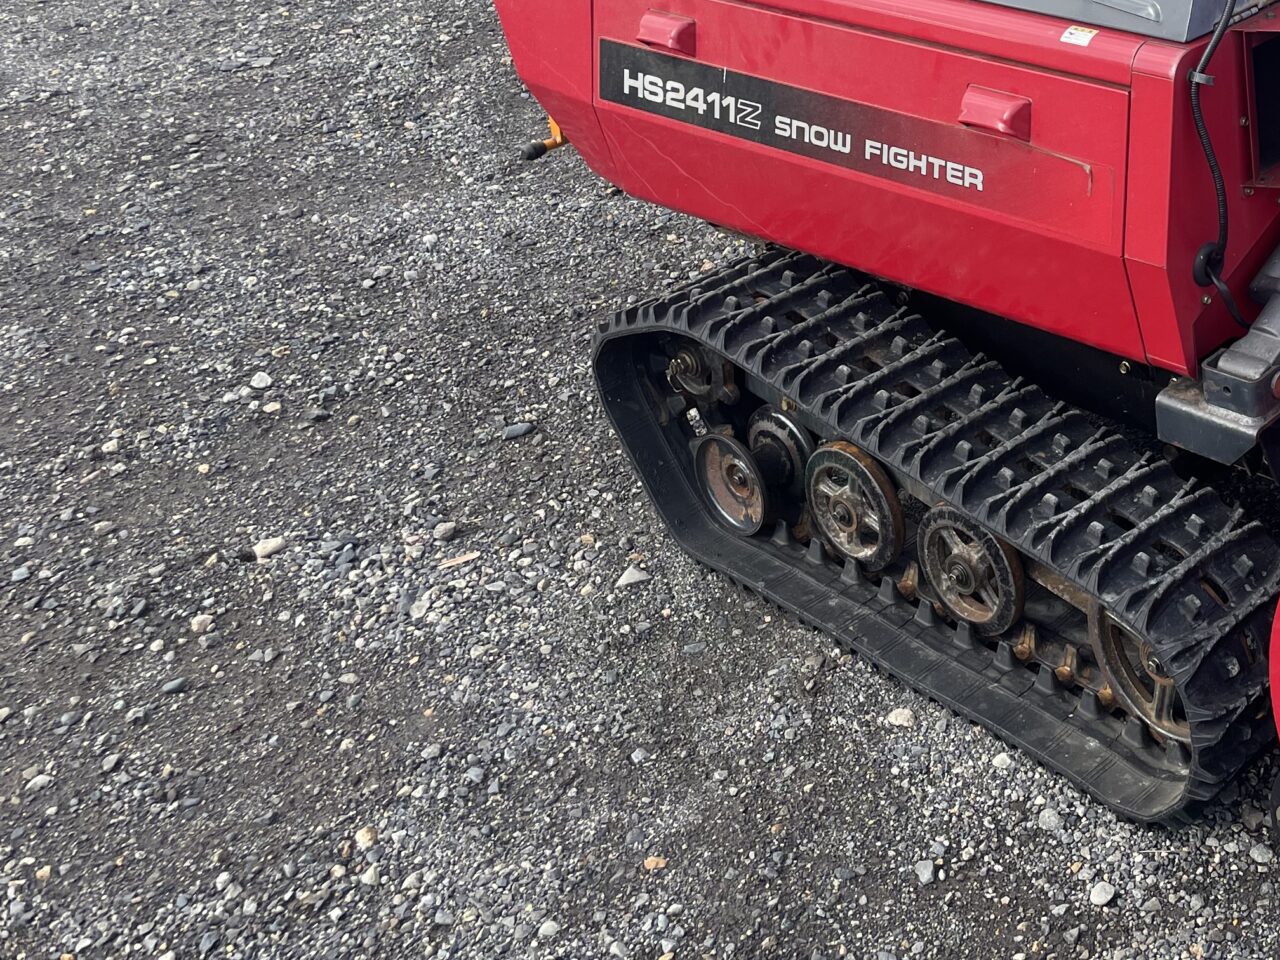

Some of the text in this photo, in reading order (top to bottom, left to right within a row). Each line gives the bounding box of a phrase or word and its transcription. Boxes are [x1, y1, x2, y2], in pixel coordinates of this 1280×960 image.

[623, 68, 984, 191] HS2411Z SNOW FIGHTER
